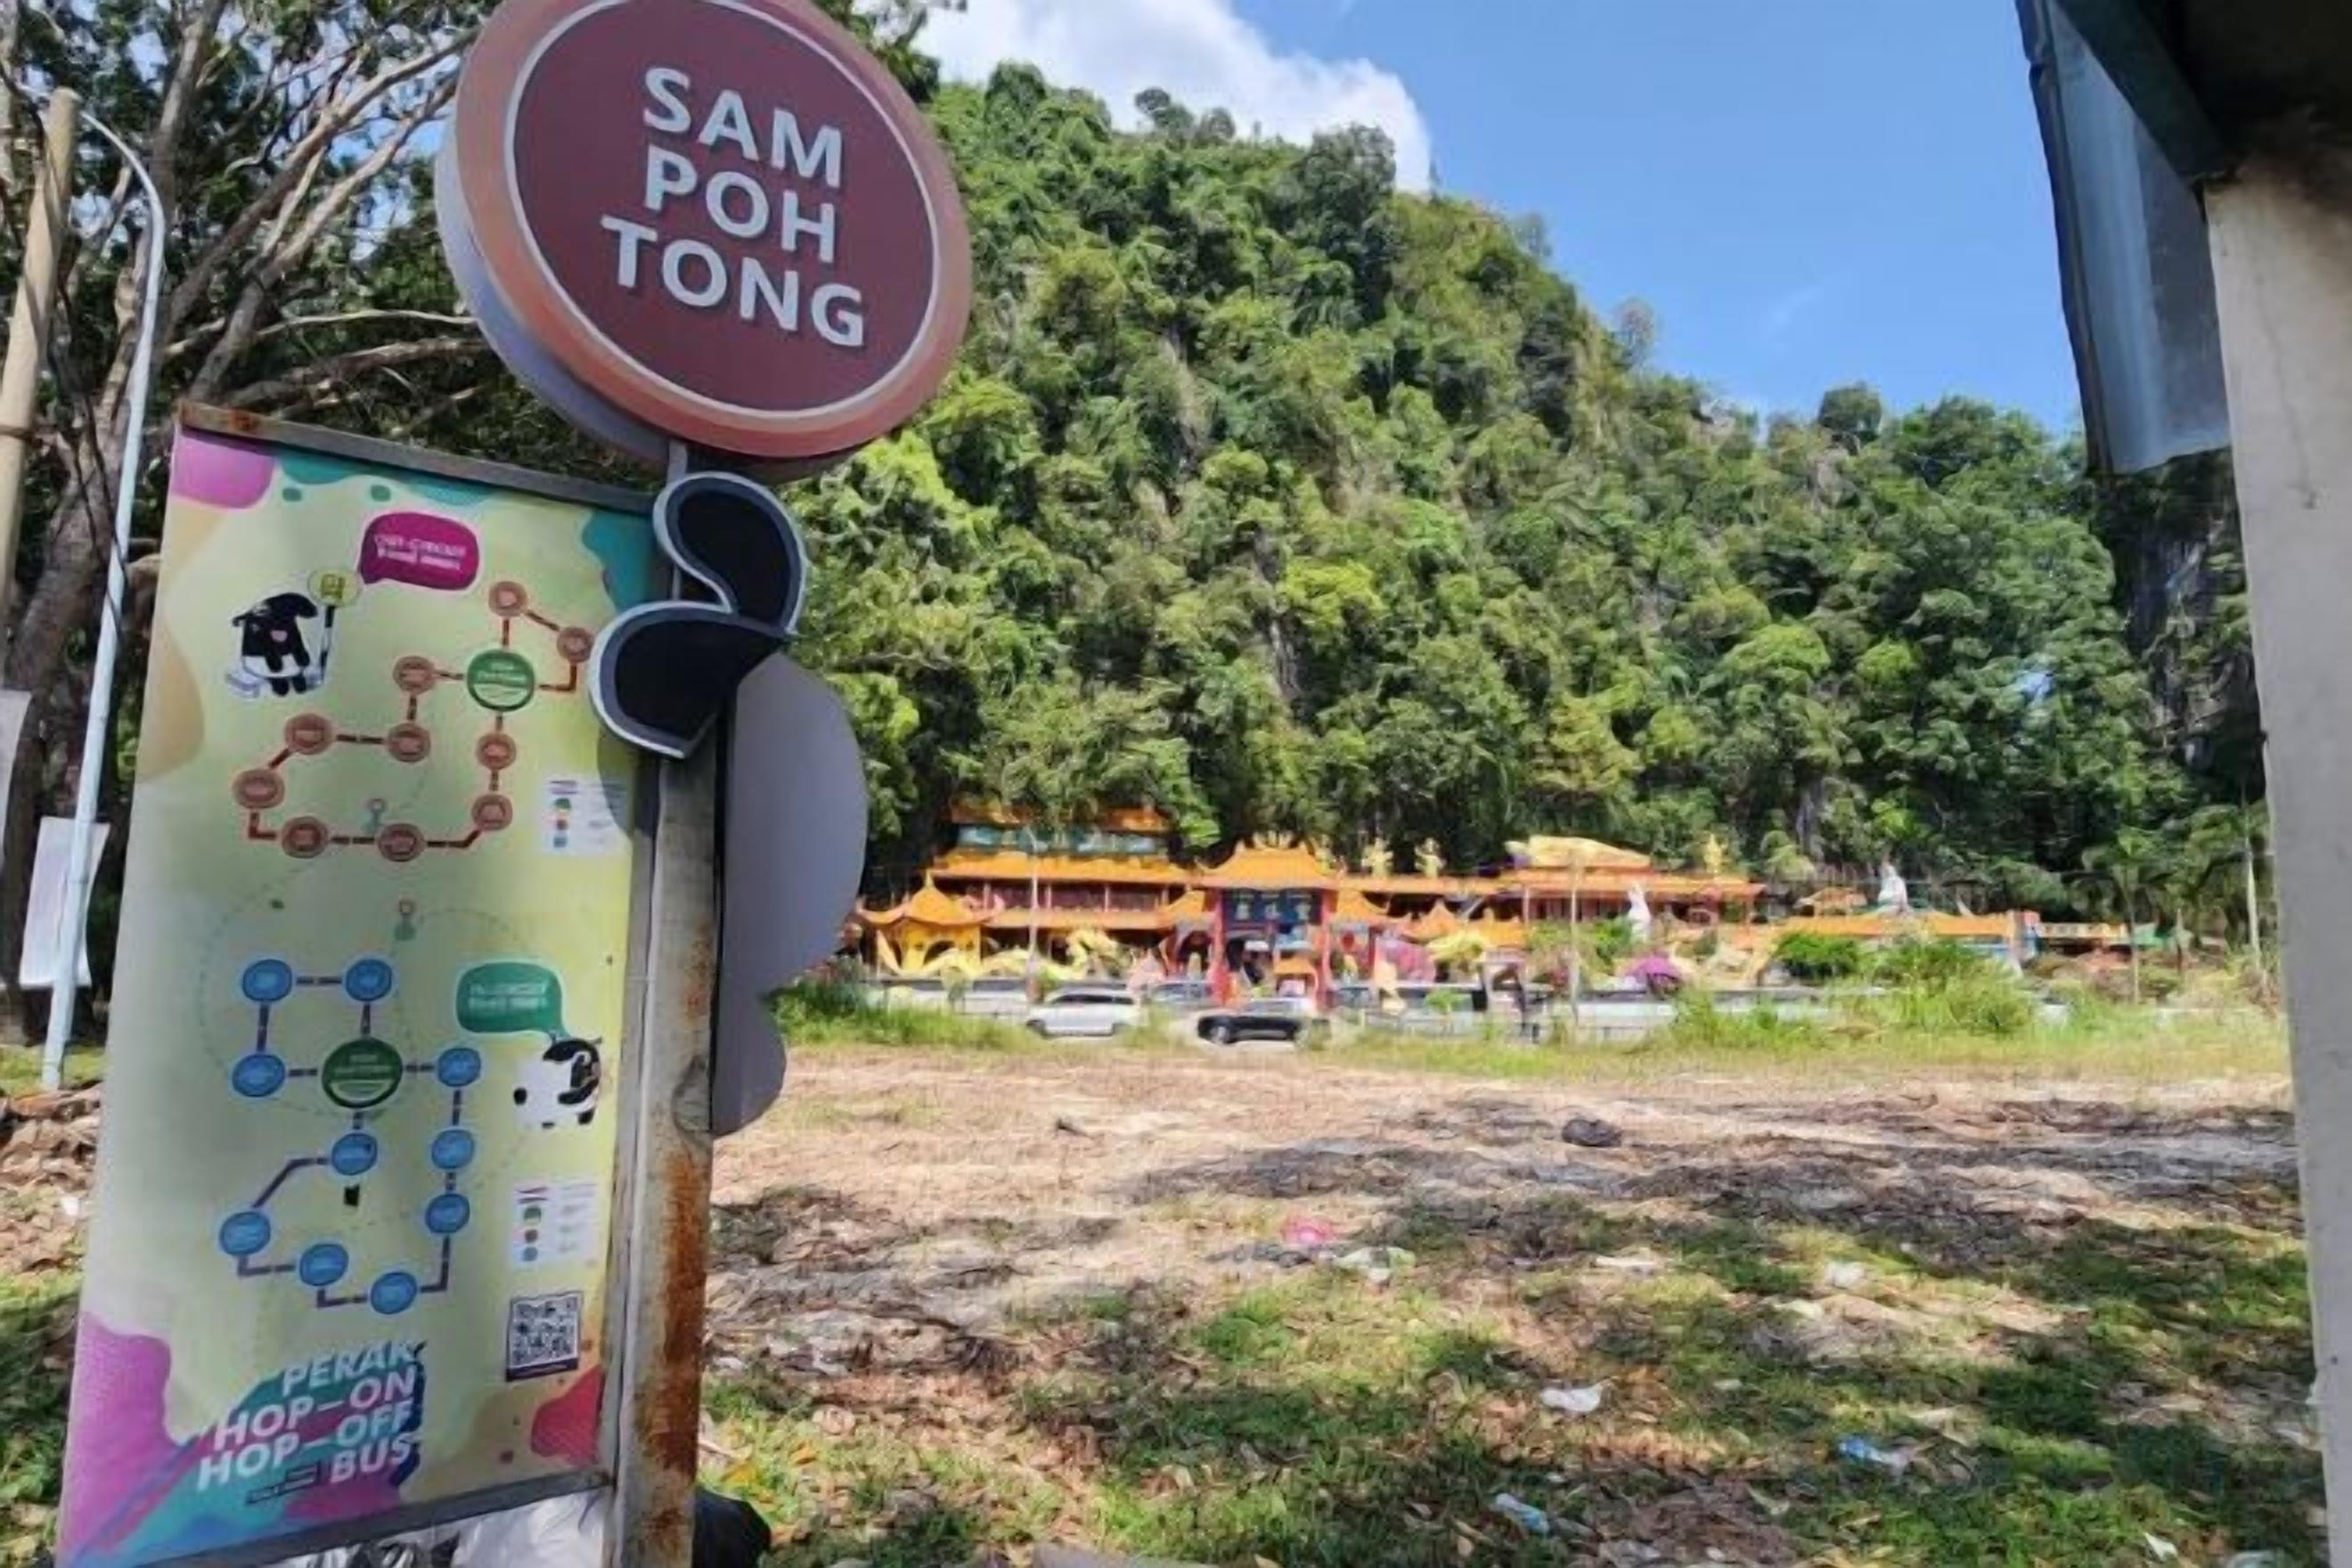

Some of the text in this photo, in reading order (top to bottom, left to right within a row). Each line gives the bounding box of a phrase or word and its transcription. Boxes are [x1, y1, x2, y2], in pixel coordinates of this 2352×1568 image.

[643, 67, 842, 188] SAM
[644, 145, 837, 264] POH
[601, 216, 865, 347] TONG
[282, 1341, 417, 1396] PERAK
[330, 1431, 413, 1483] BUS
